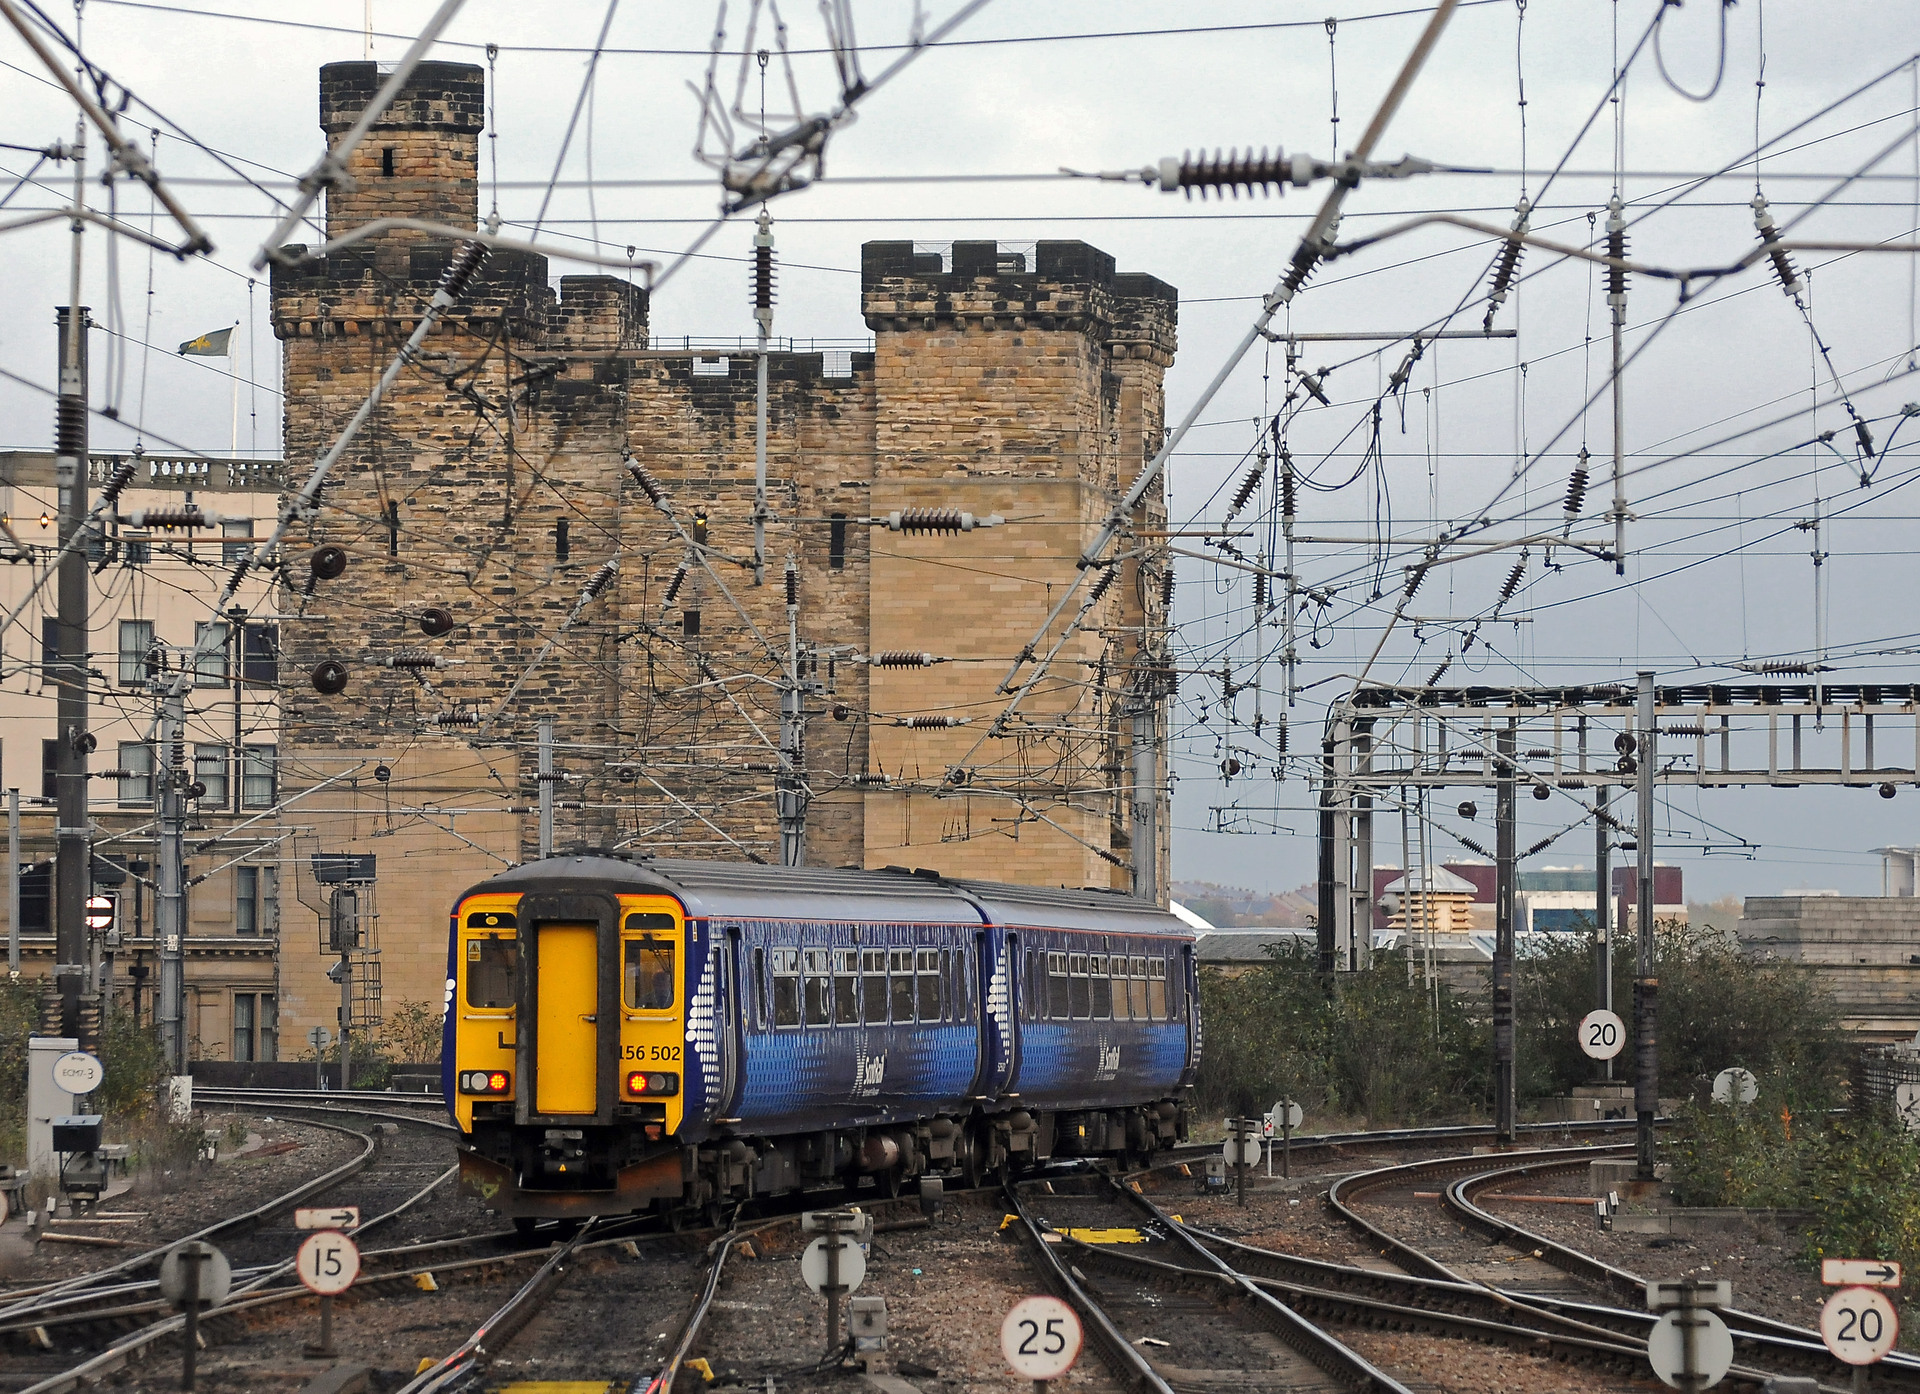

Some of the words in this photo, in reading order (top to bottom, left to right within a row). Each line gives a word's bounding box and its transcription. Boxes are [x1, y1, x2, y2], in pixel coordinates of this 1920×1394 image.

[1589, 1023, 1617, 1047] 20
[650, 1045, 681, 1061] 502
[315, 1248, 342, 1276] 15
[1018, 1319, 1066, 1355] 25
[1837, 1307, 1883, 1342] 20
